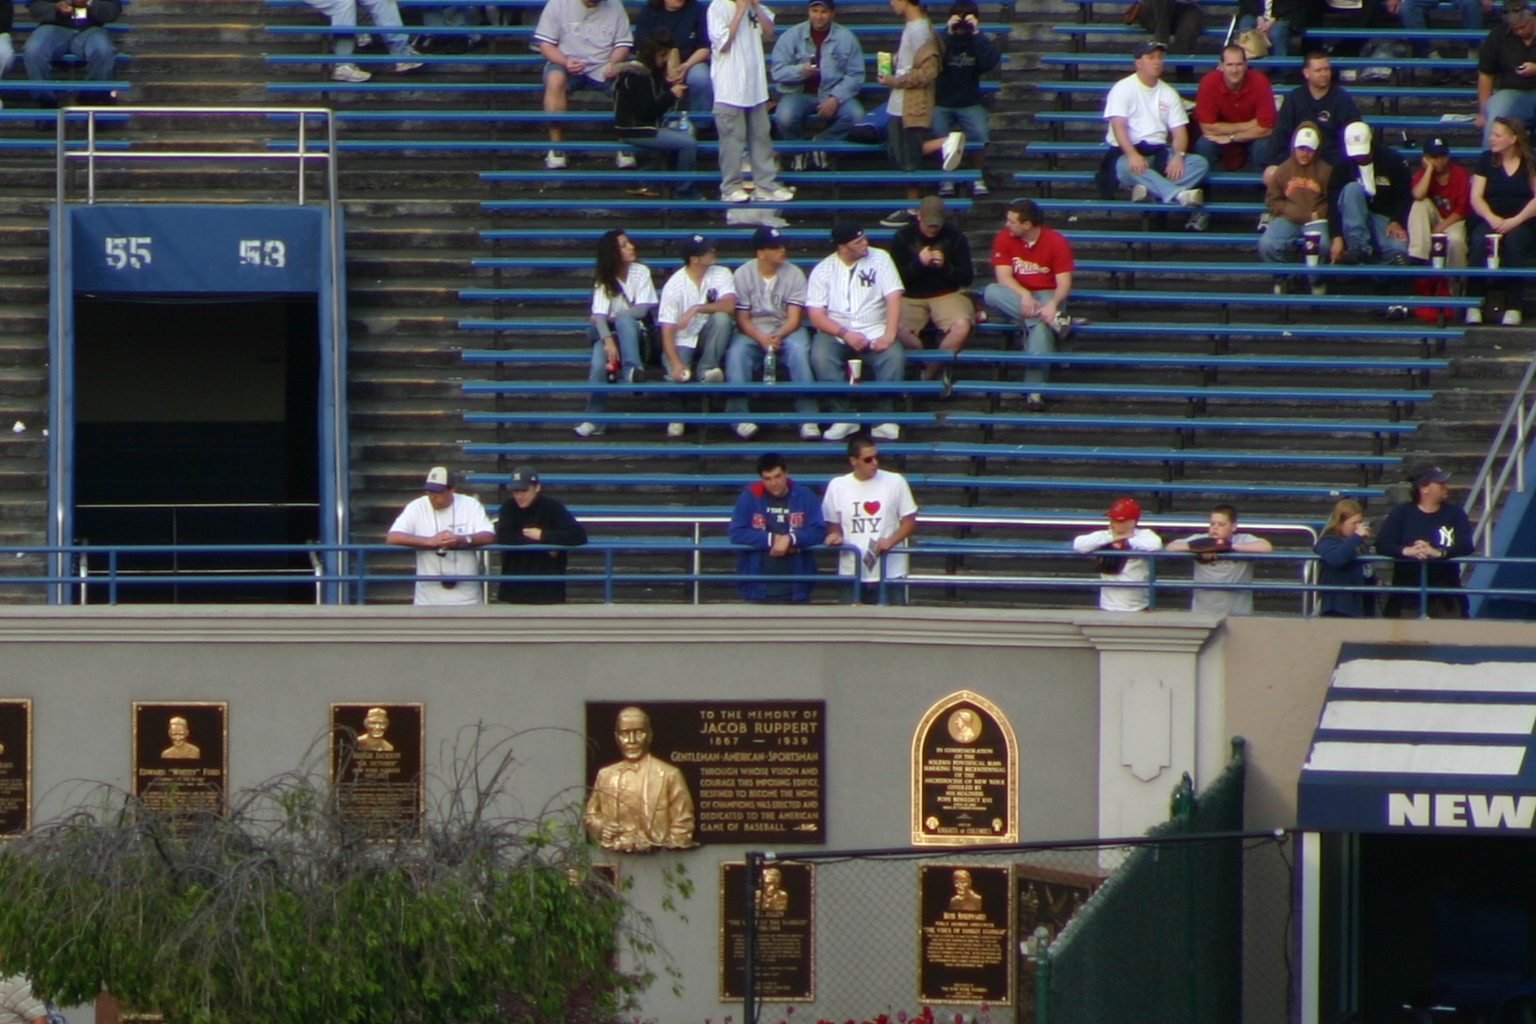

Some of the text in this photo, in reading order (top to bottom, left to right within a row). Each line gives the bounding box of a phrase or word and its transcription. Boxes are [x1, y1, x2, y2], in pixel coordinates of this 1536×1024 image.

[105, 236, 152, 270] 55
[239, 240, 286, 268] 53
[851, 501, 861, 518] I
[850, 517, 883, 535] NY
[1438, 525, 1455, 548] NY
[699, 710, 818, 720] TO THE MEMORY OF
[699, 721, 819, 735] JACOB RUPPERT
[709, 737, 809, 746] 1867 1939
[699, 767, 819, 776] THROUGH WHOSE VISION AND
[699, 811, 819, 821] DEDICATED TO THE AMERICAN
[1388, 792, 1536, 829] NEW
[699, 823, 725, 832] GAME
[726, 823, 739, 832] OF
